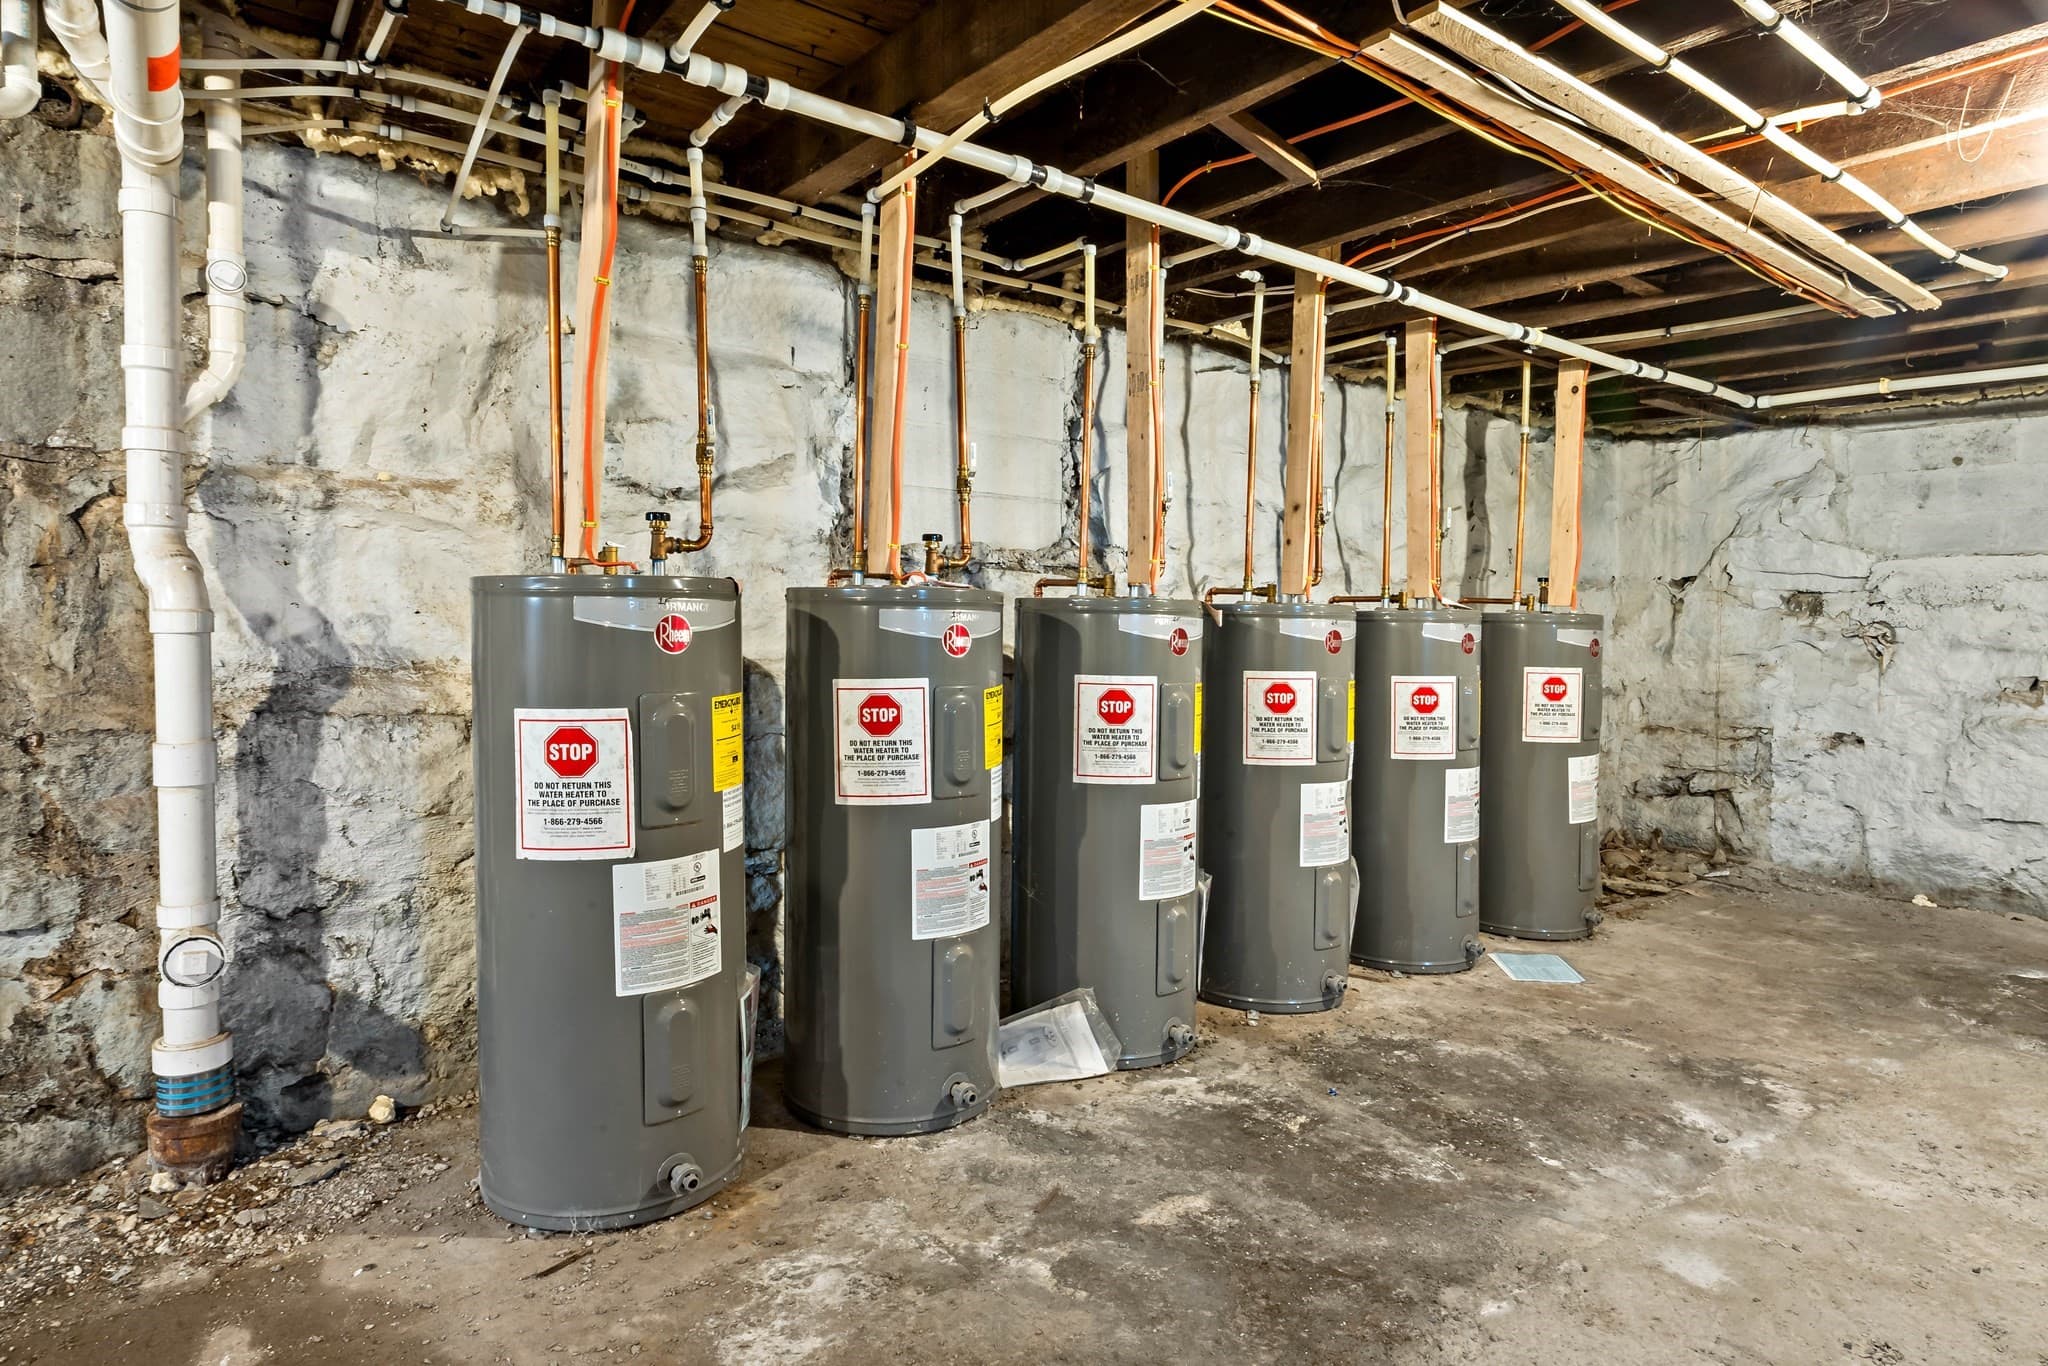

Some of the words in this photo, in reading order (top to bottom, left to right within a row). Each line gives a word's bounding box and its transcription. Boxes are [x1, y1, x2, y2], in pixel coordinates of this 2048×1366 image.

[1544, 685, 1566, 693] STOP
[1266, 693, 1294, 704] STOP
[1413, 695, 1437, 705] STOP
[1101, 701, 1132, 713] STOP
[862, 708, 898, 722] STOP
[549, 744, 592, 761] STOP
[580, 799, 620, 807] PURCHASE
